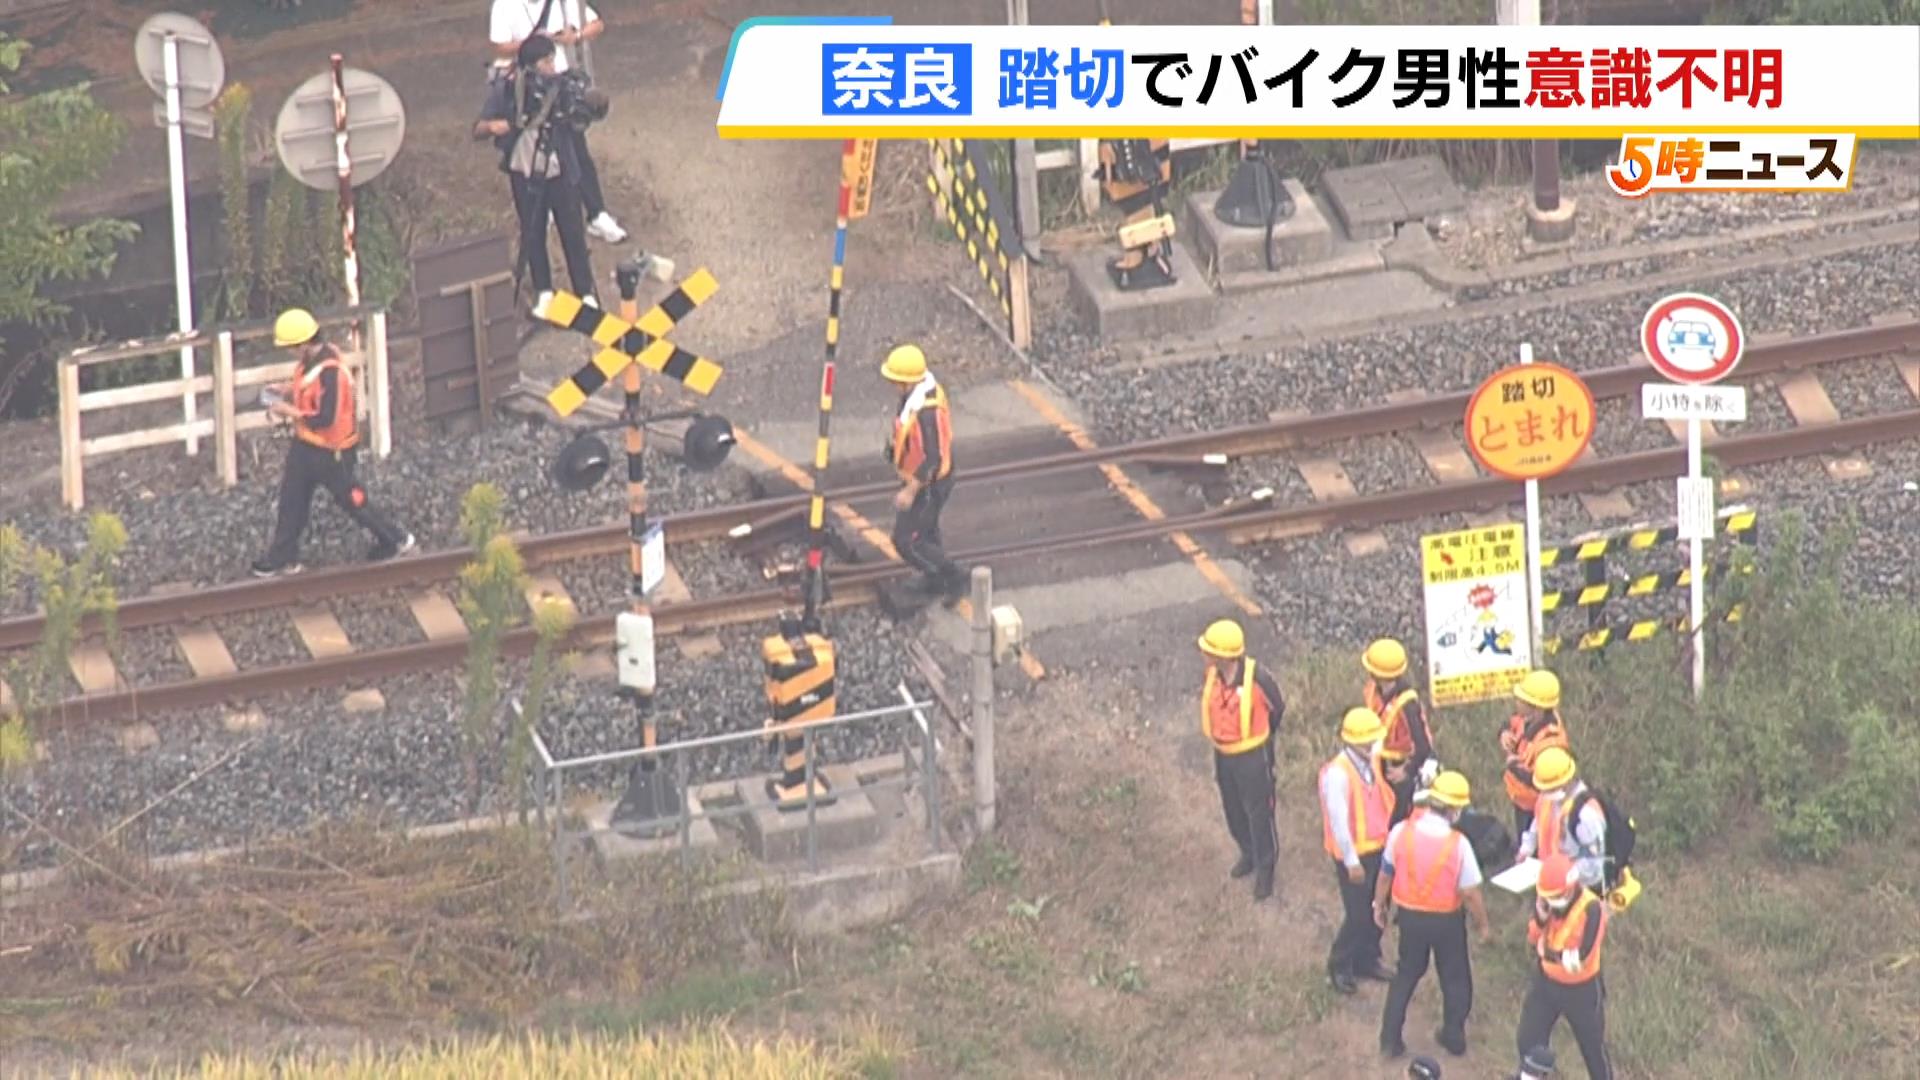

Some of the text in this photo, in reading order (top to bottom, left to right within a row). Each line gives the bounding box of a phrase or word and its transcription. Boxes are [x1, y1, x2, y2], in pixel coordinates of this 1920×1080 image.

[1502, 376, 1555, 404] 踏切
[1479, 404, 1585, 452] とまれ
